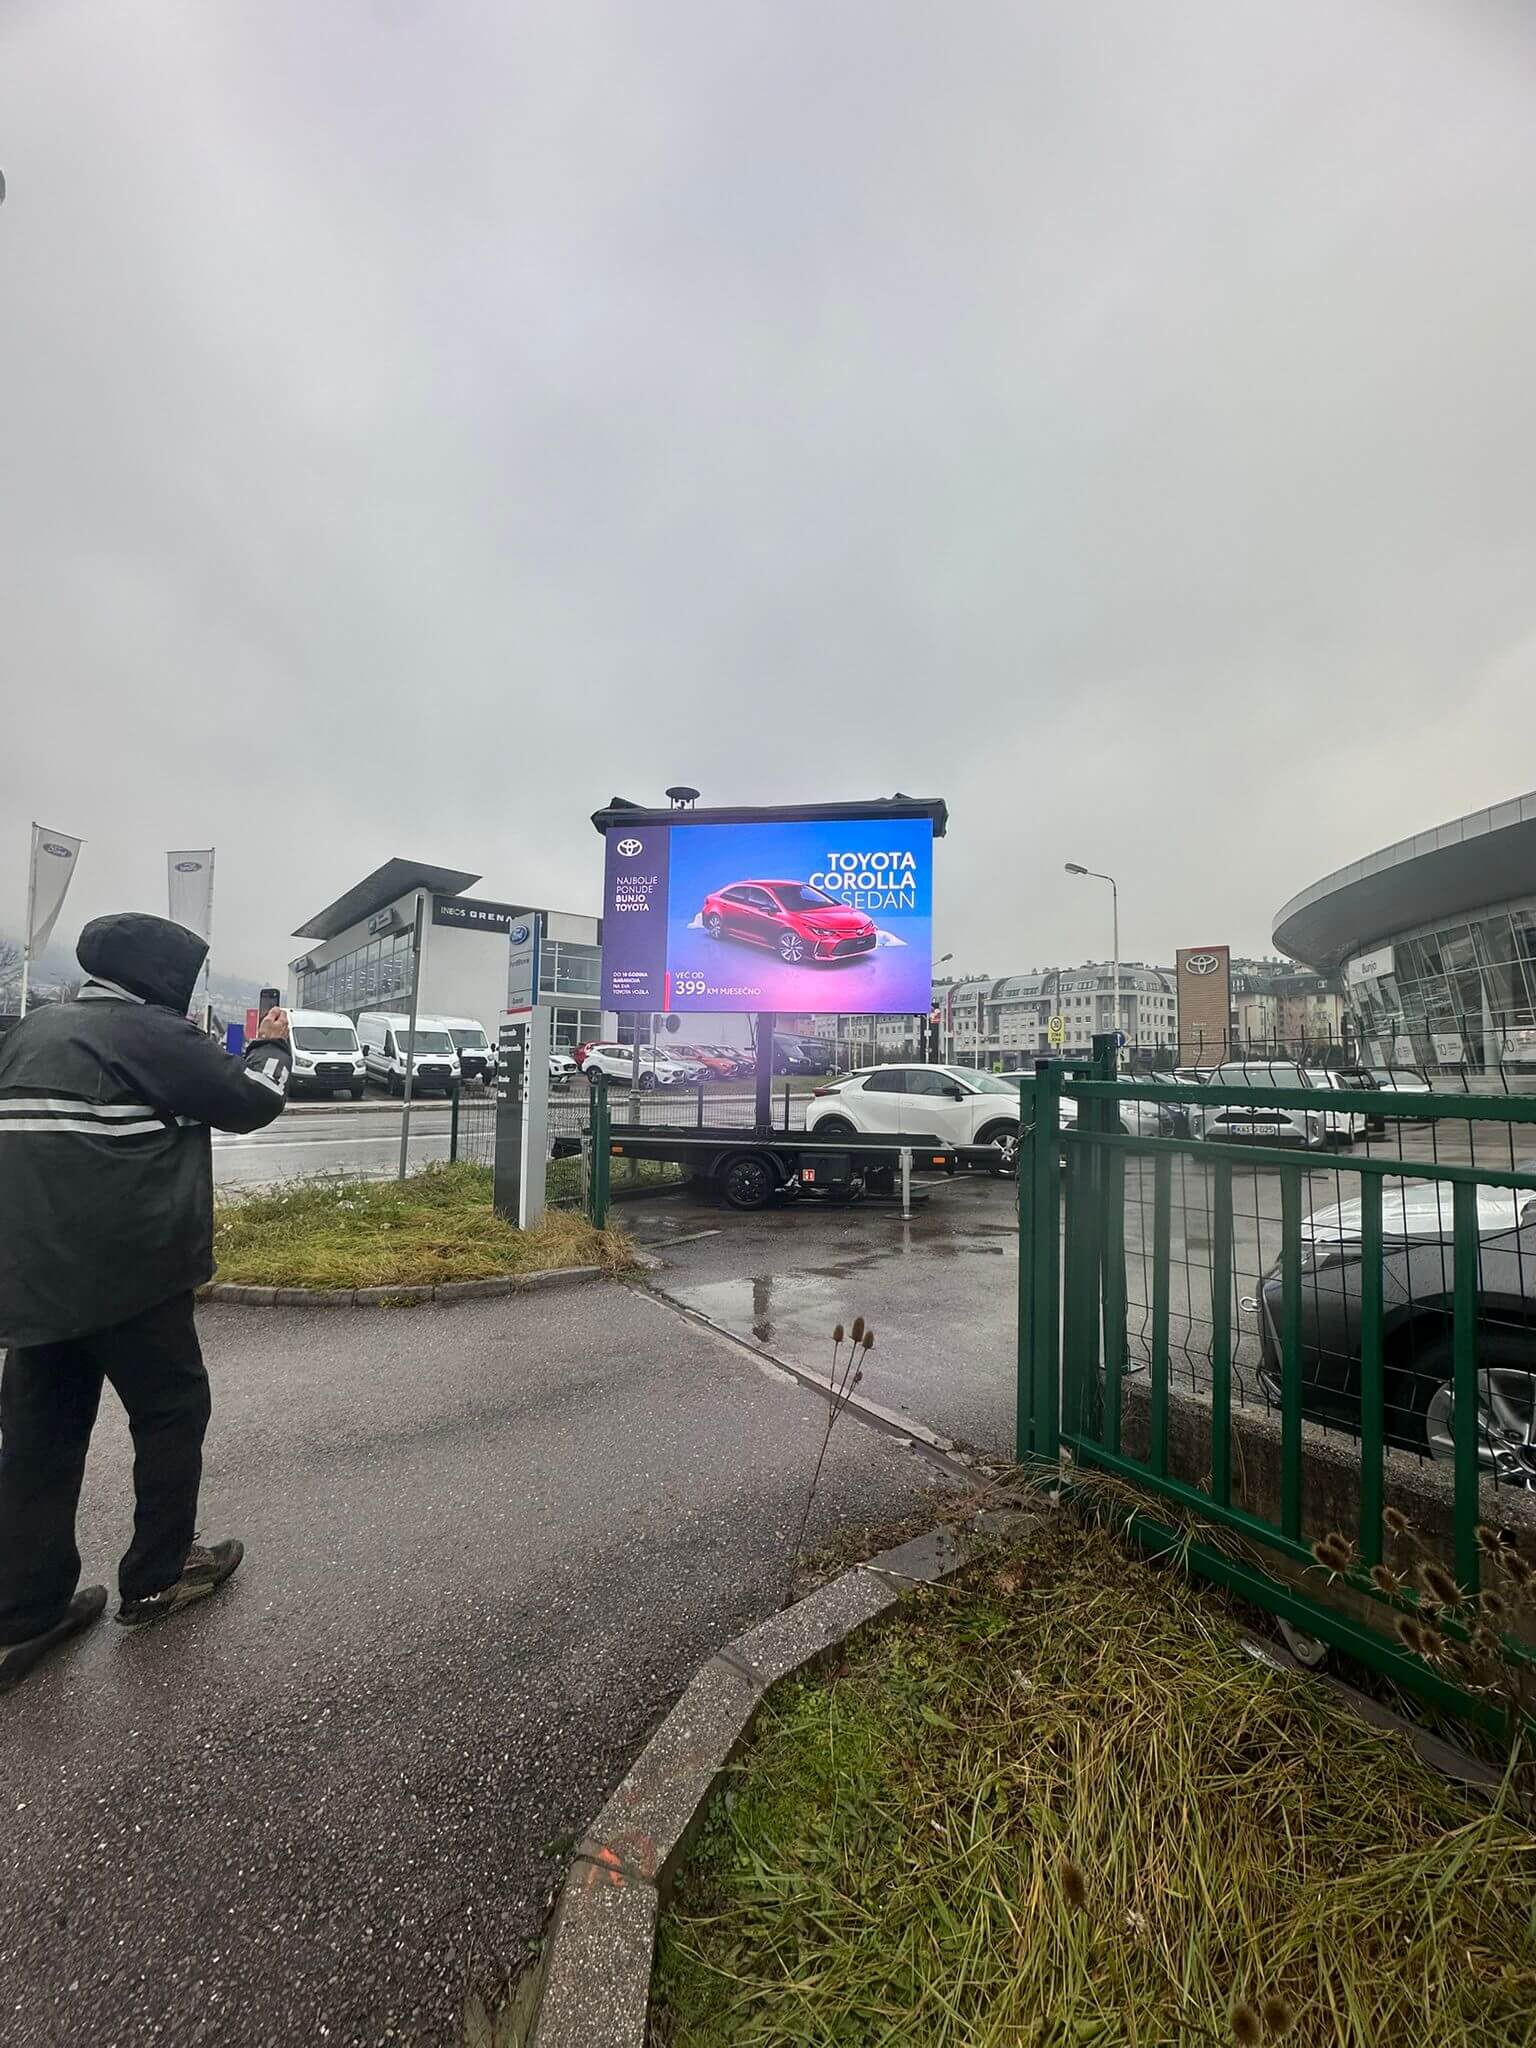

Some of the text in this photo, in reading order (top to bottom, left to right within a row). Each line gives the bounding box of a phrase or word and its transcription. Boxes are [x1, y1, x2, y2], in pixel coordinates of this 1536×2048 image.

[827, 851, 917, 871] TOYOTA
[616, 876, 658, 885] NAJBOLJE
[809, 871, 917, 890] COROLLA
[616, 885, 654, 894] PONUDE
[615, 894, 646, 903] BUNJO
[841, 890, 915, 909] SEDAN
[615, 903, 650, 912] TOYOTA
[440, 906, 512, 923] INEOS GRENA
[691, 971, 704, 979] OD
[675, 981, 706, 995] 399
[707, 987, 718, 995] KM
